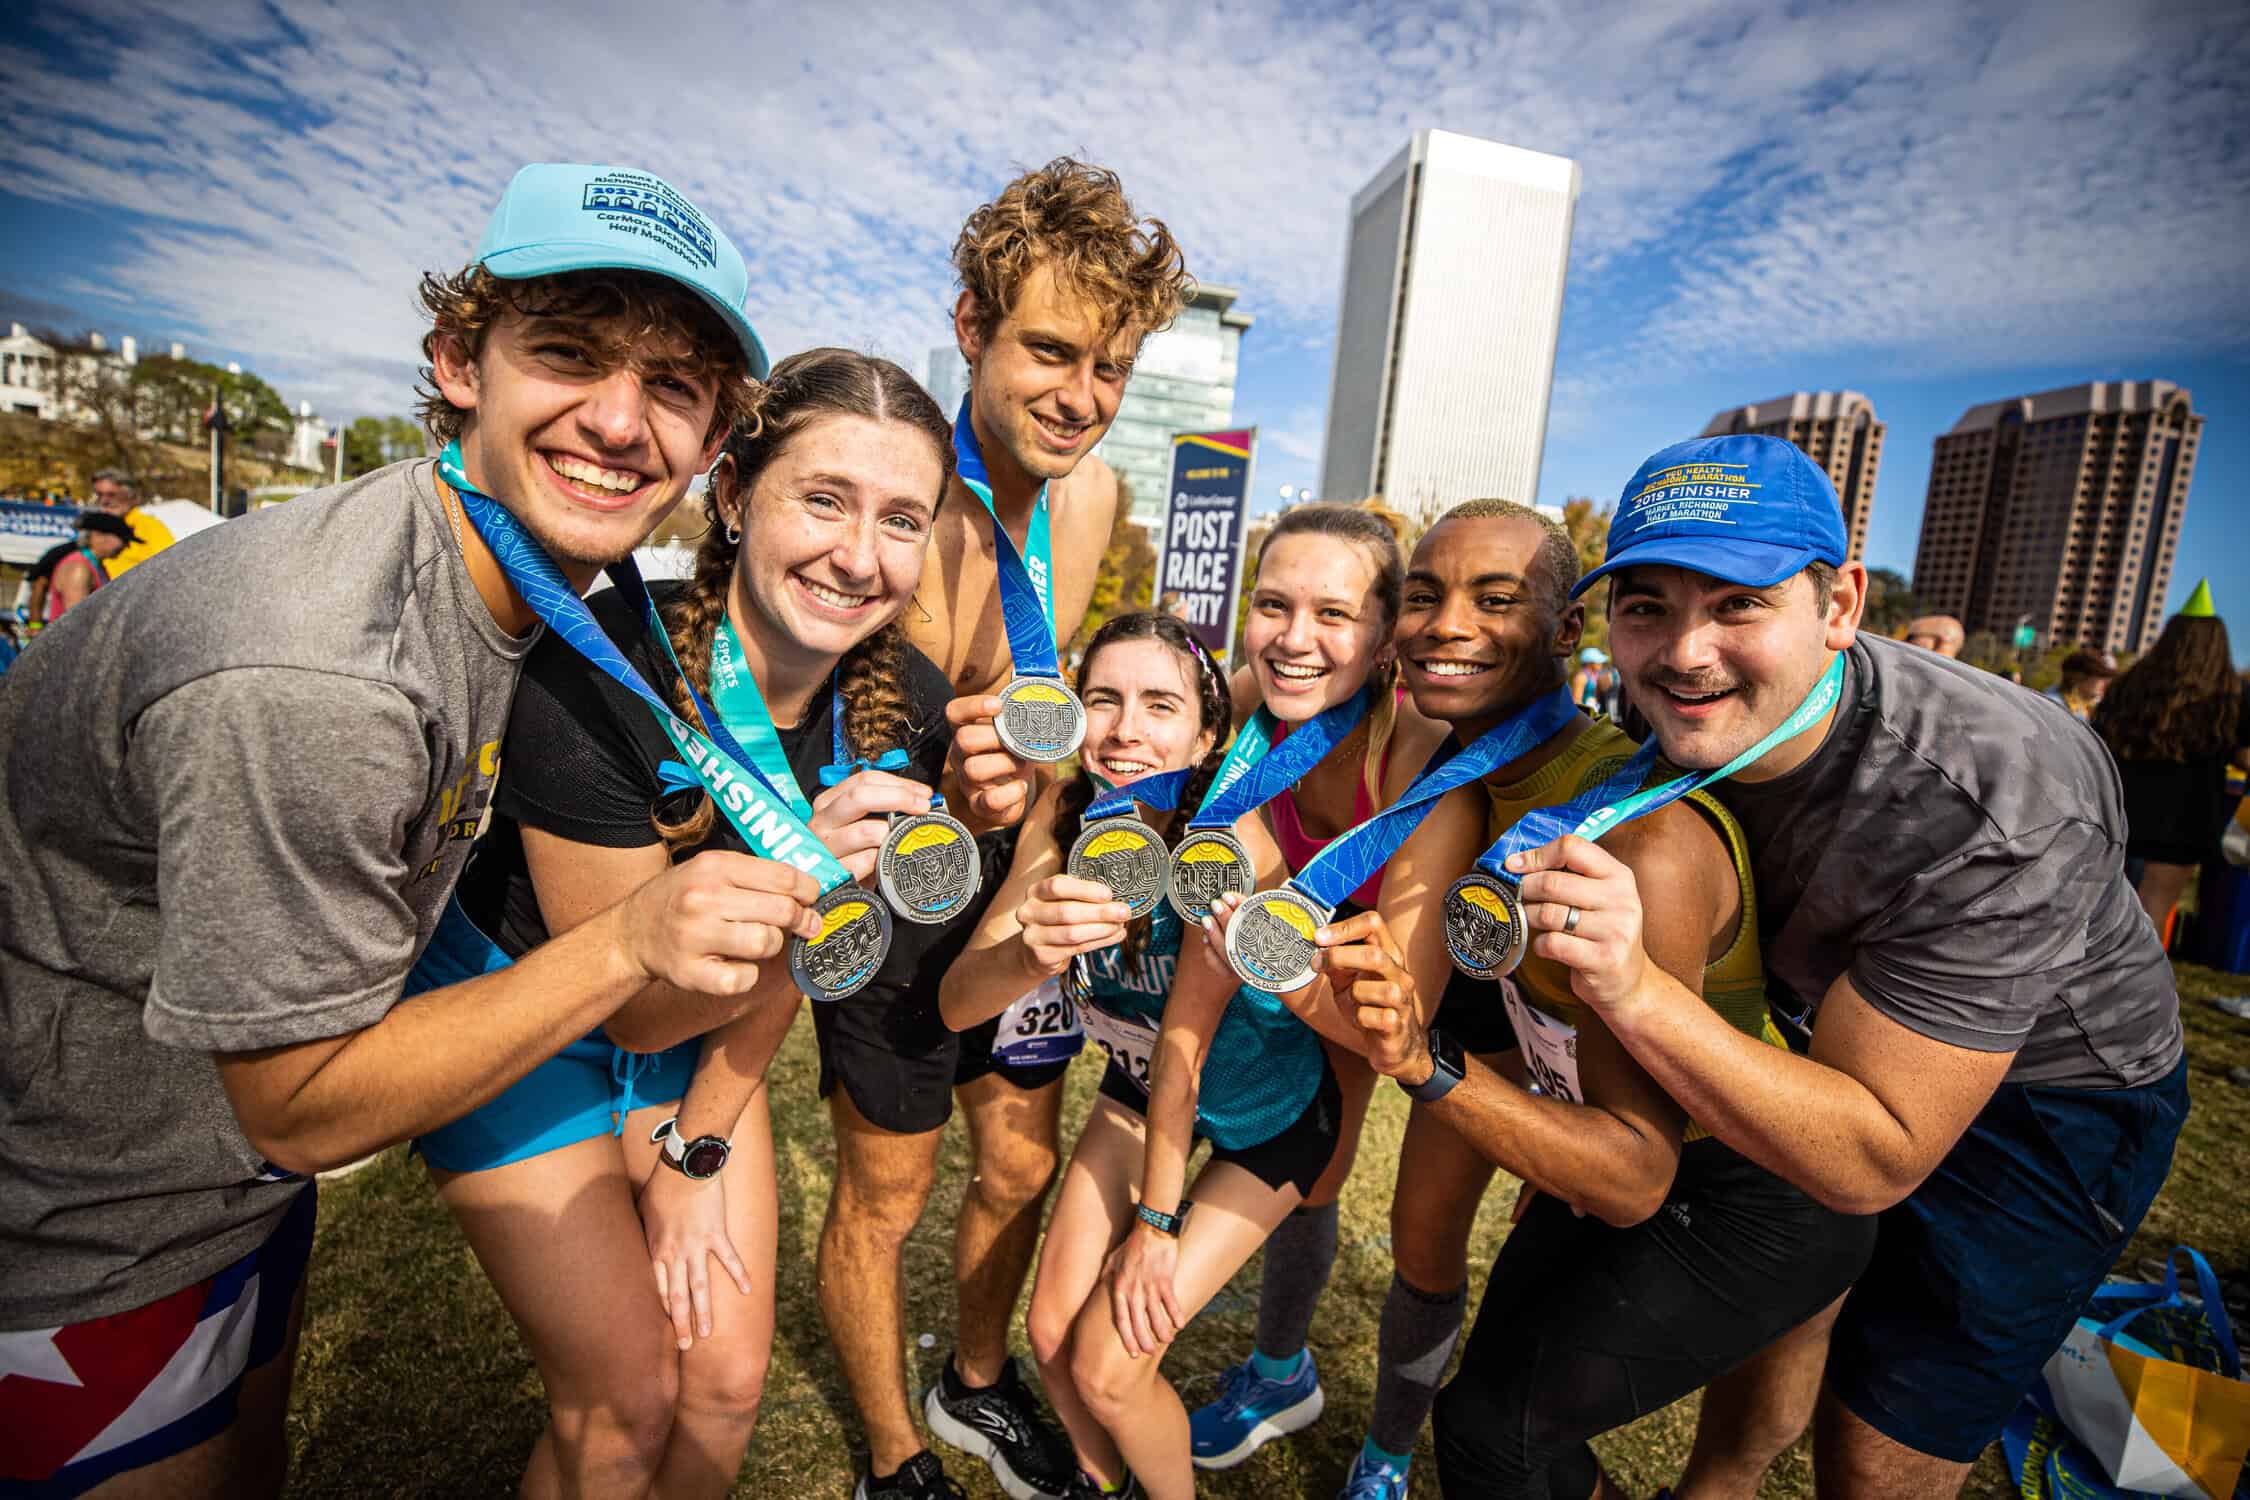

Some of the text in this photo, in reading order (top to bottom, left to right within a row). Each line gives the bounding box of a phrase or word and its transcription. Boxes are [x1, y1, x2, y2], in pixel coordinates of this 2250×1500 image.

[592, 187, 639, 198] 2022
[596, 213, 708, 268] CarMax Richmond
[608, 222, 698, 270] Half Marathon
[1686, 466, 1723, 474] HEALTH
[1691, 473, 1745, 483] MARATHON
[1634, 485, 1751, 509] 2019 FINISHER
[1678, 500, 1729, 512] RICHMOND
[1669, 509, 1722, 520] MARATHON
[1170, 510, 1235, 551] POST
[1166, 552, 1229, 592] RACE
[717, 641, 739, 689] SPORTS
